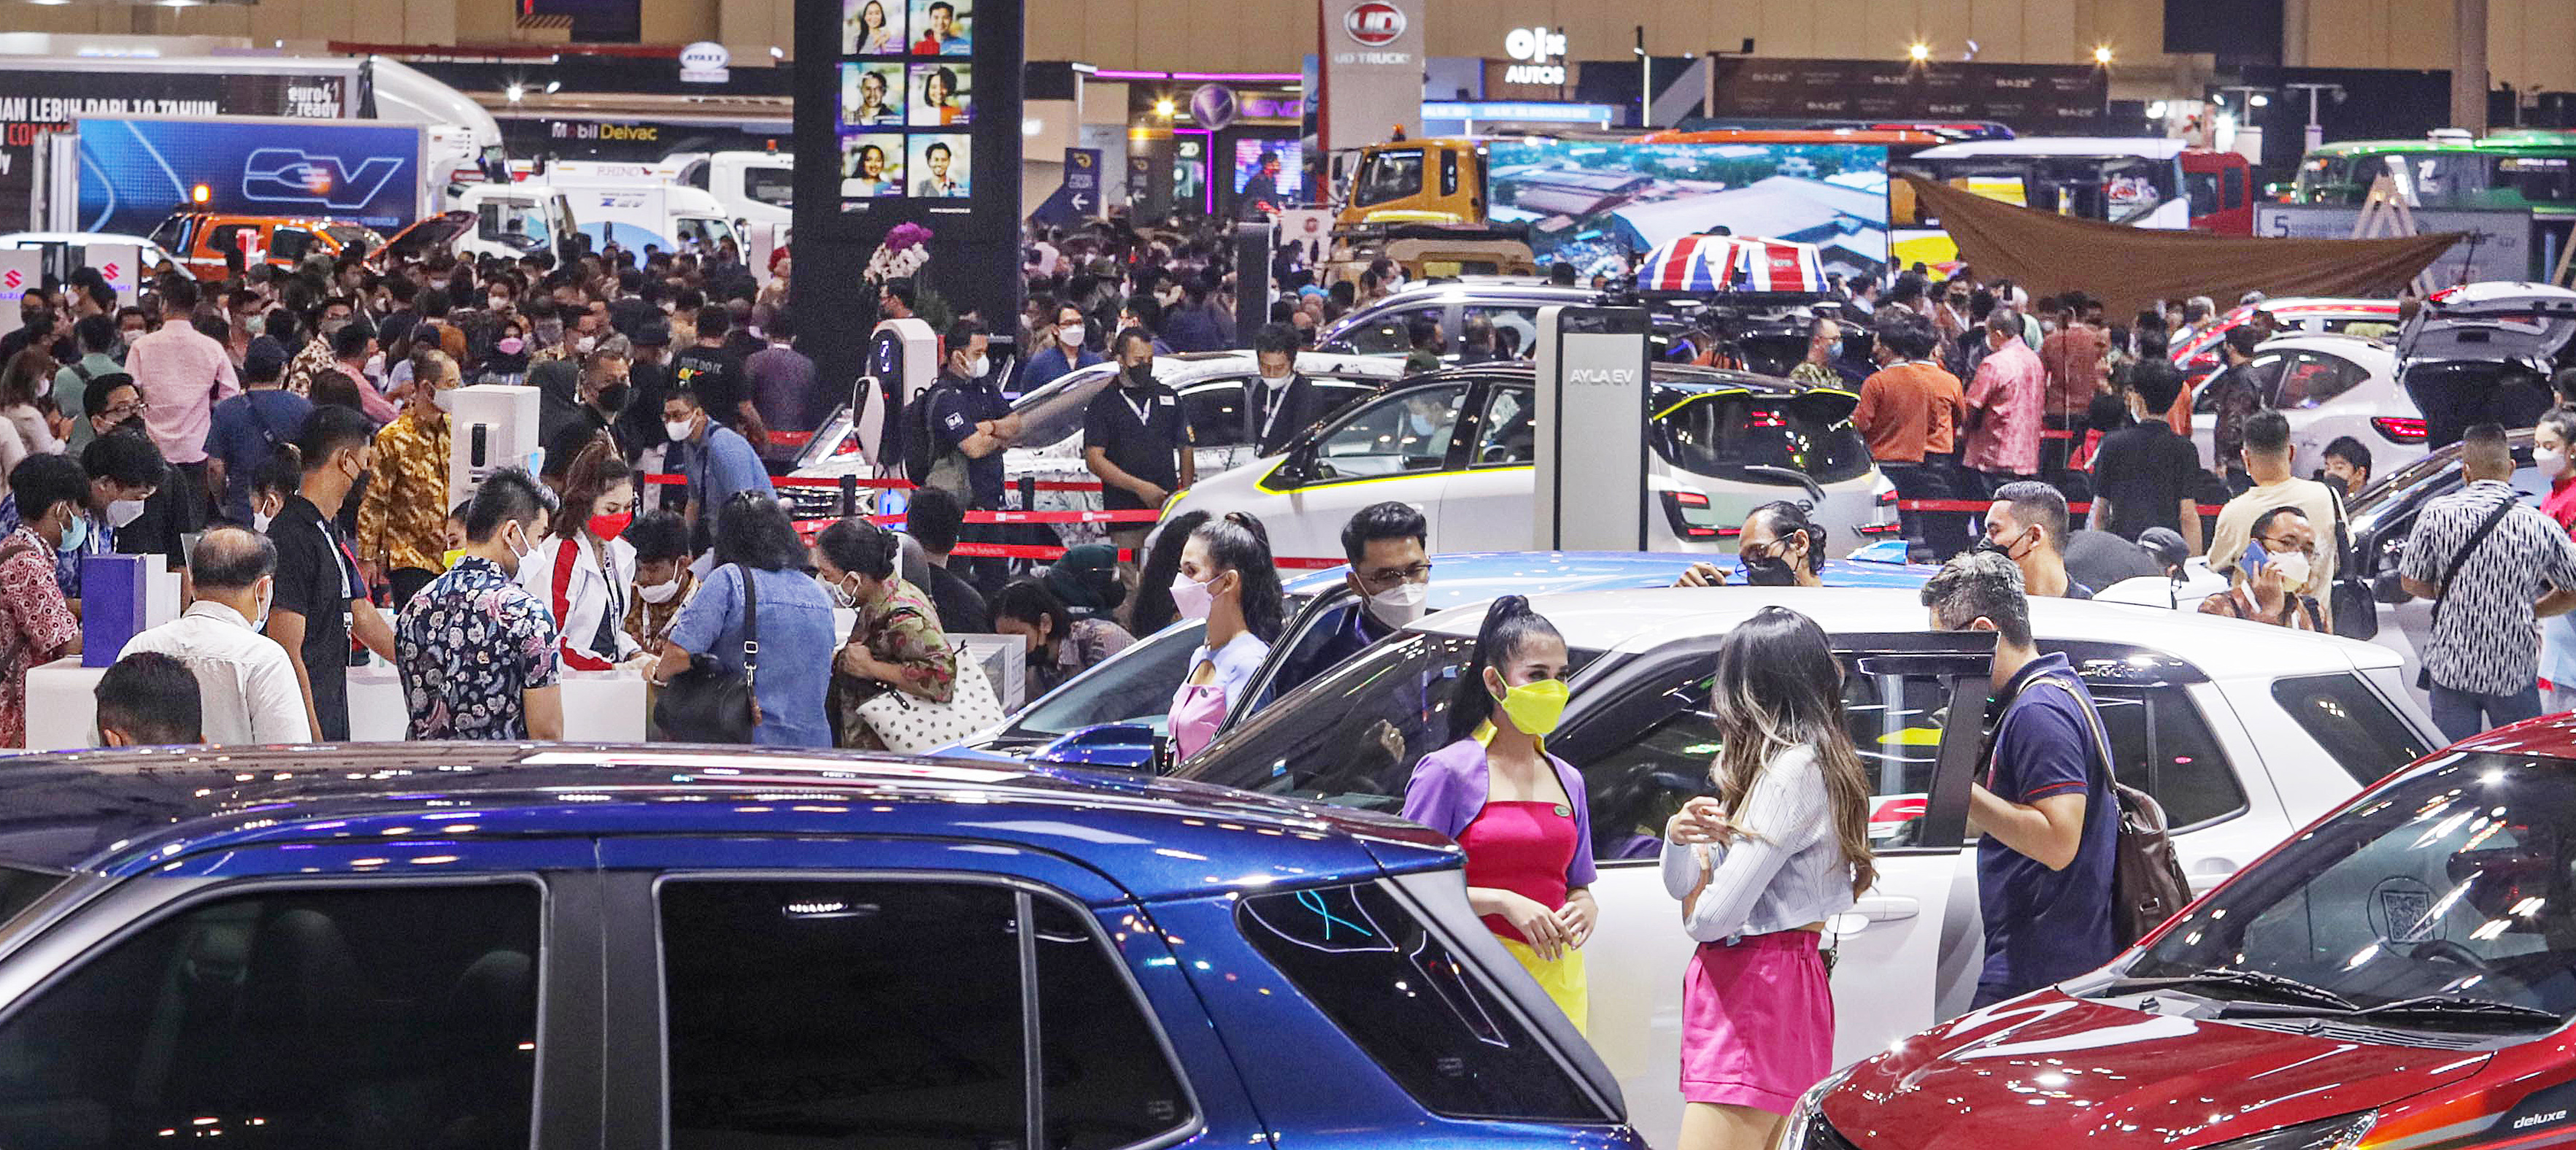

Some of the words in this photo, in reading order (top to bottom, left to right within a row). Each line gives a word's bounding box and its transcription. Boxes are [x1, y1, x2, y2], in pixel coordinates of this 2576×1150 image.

[1505, 65, 1565, 84] AUTOS
[0, 98, 26, 121] AN
[31, 99, 82, 122] LEBIH
[297, 102, 339, 118] ready
[552, 123, 598, 139] Mobil
[601, 123, 658, 141] Delvac
[1570, 369, 1610, 384] AYLA
[1613, 368, 1635, 384] EV
[2513, 1110, 2567, 1129] deluxe
